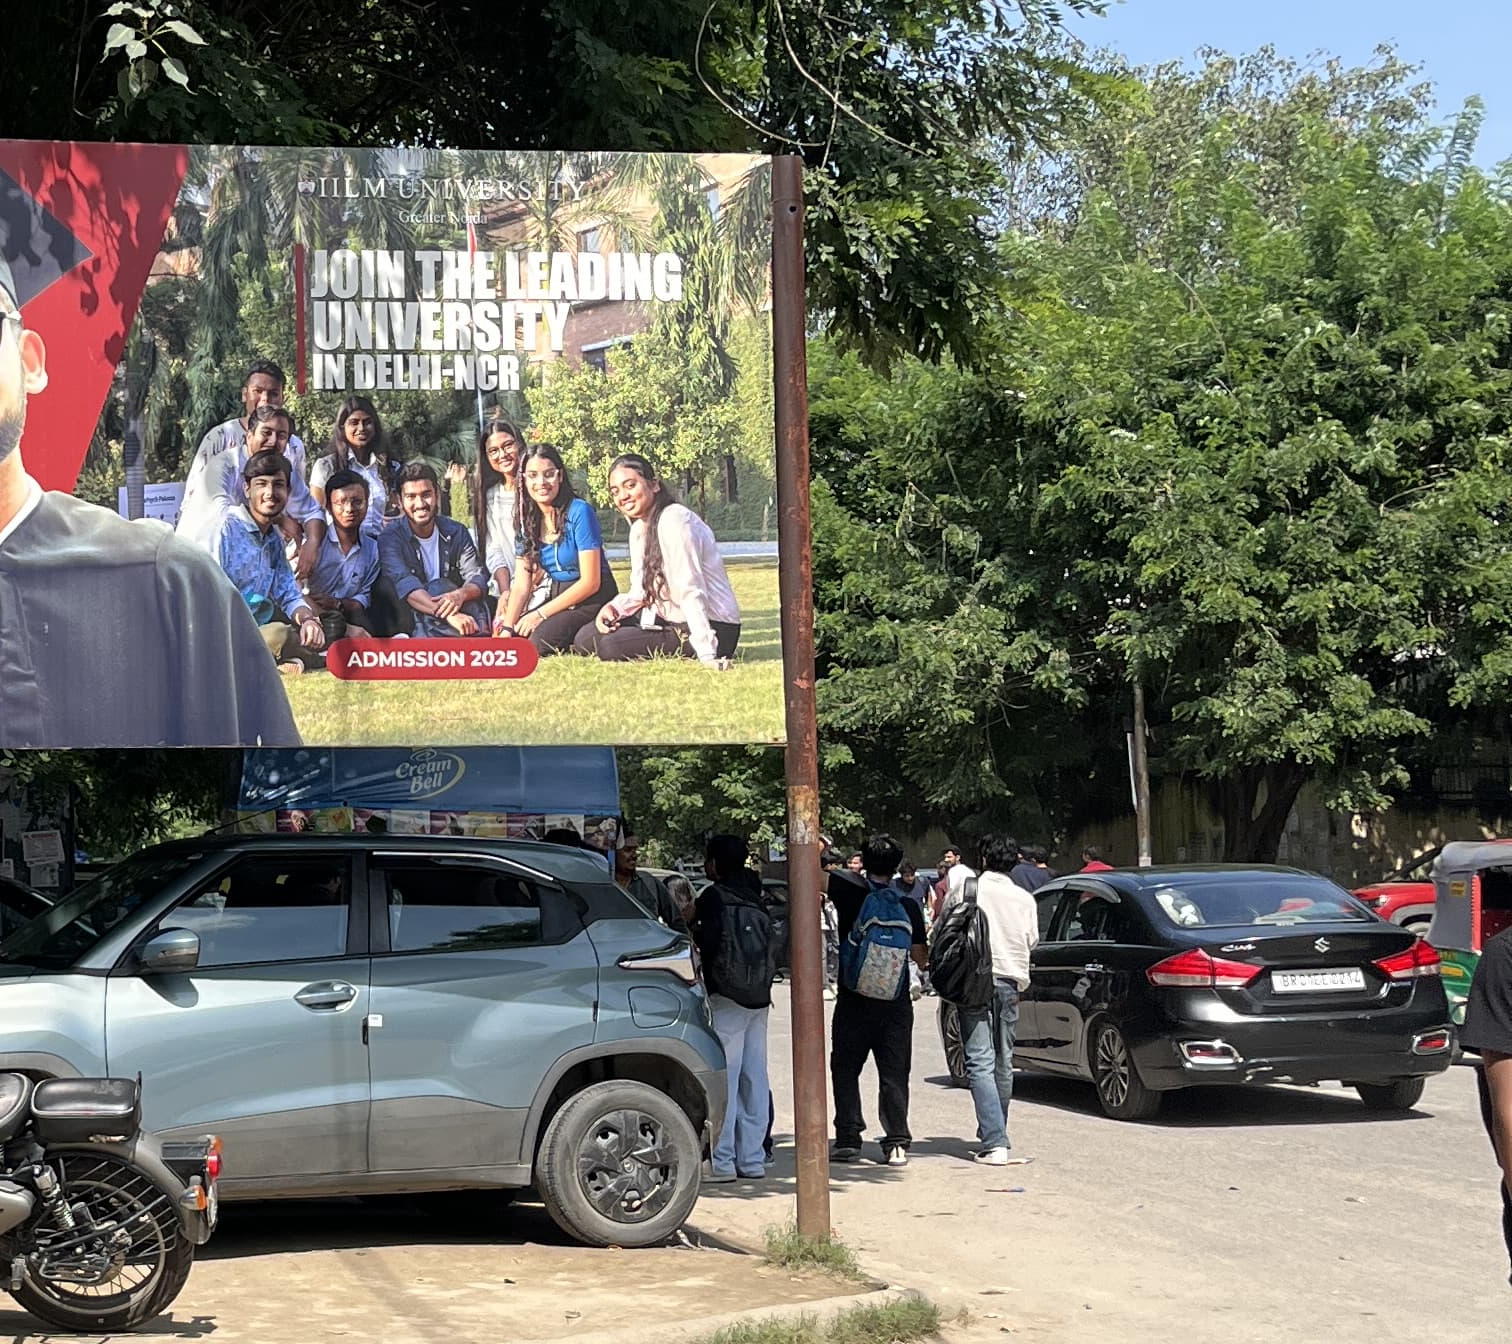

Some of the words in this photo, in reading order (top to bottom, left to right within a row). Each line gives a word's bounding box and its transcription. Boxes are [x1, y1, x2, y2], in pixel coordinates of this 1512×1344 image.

[319, 177, 386, 198] IILM
[398, 177, 587, 201] UNIVERSITY
[399, 210, 446, 224] Greater
[450, 210, 488, 224] Noida
[310, 248, 405, 299] JOIN
[414, 249, 497, 300] THE
[505, 250, 683, 302] LEADING
[312, 300, 571, 352] UNIVERSITY
[312, 353, 345, 390] IN
[353, 353, 520, 391] DELHI-NCR
[347, 650, 465, 668] ADMISSION
[470, 650, 518, 667] 2025
[395, 759, 452, 779] Cream
[410, 771, 443, 794] Bell
